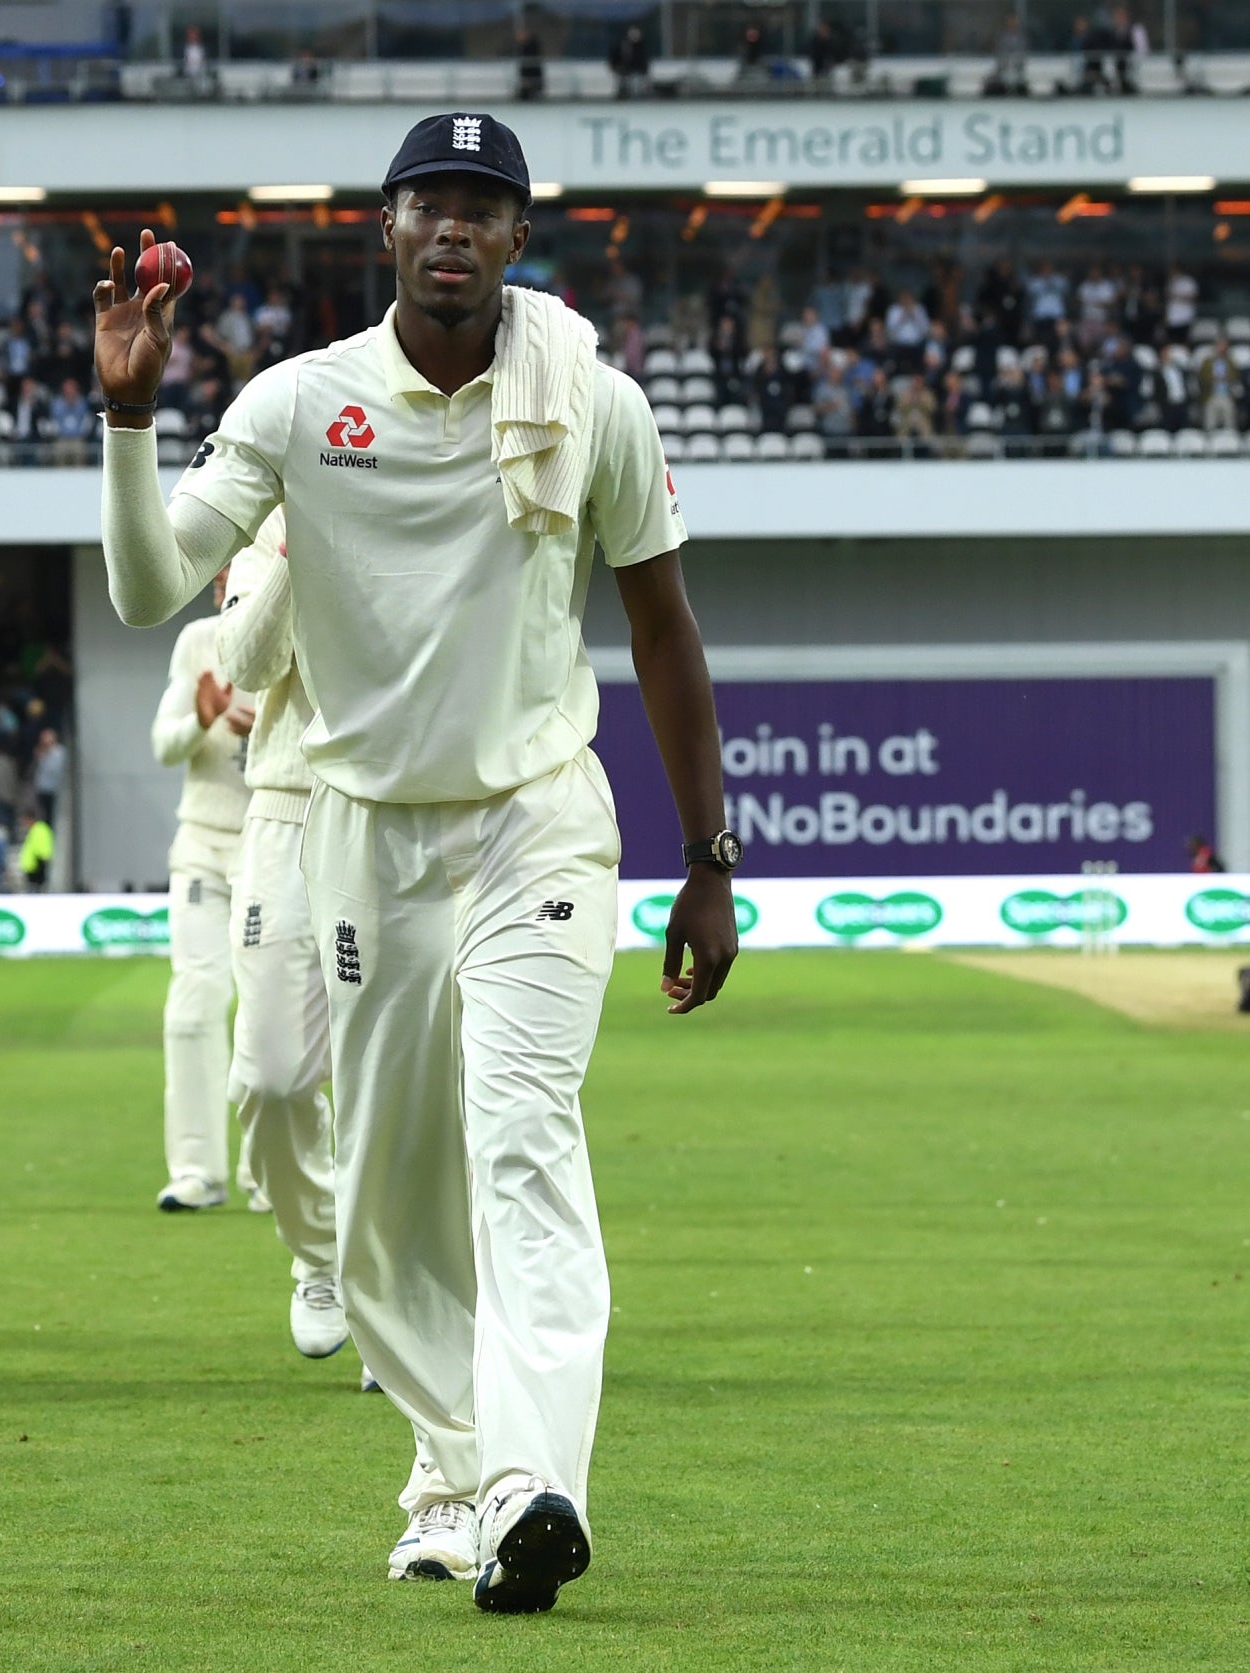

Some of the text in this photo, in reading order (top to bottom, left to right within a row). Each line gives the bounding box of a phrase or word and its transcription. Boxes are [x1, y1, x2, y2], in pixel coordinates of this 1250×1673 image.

[580, 111, 1125, 169] The Emerald Stand
[319, 452, 379, 469] NatWest
[719, 722, 940, 776] oin in at
